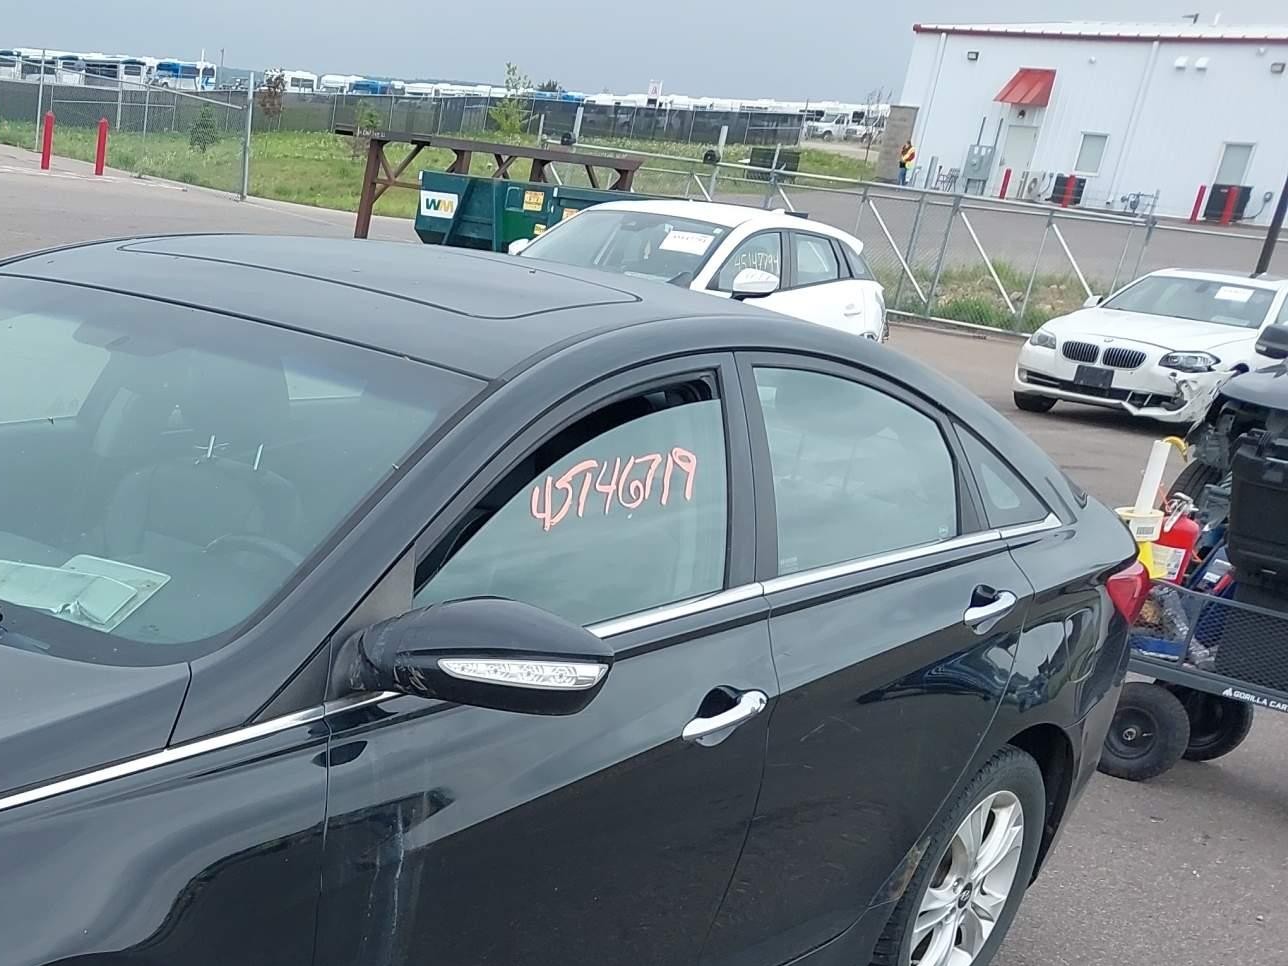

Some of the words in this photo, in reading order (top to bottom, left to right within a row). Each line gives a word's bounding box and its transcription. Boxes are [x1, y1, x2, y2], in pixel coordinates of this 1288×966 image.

[425, 197, 454, 213] WM
[531, 447, 697, 532] 45146719
[1233, 690, 1268, 706] GORILLA
